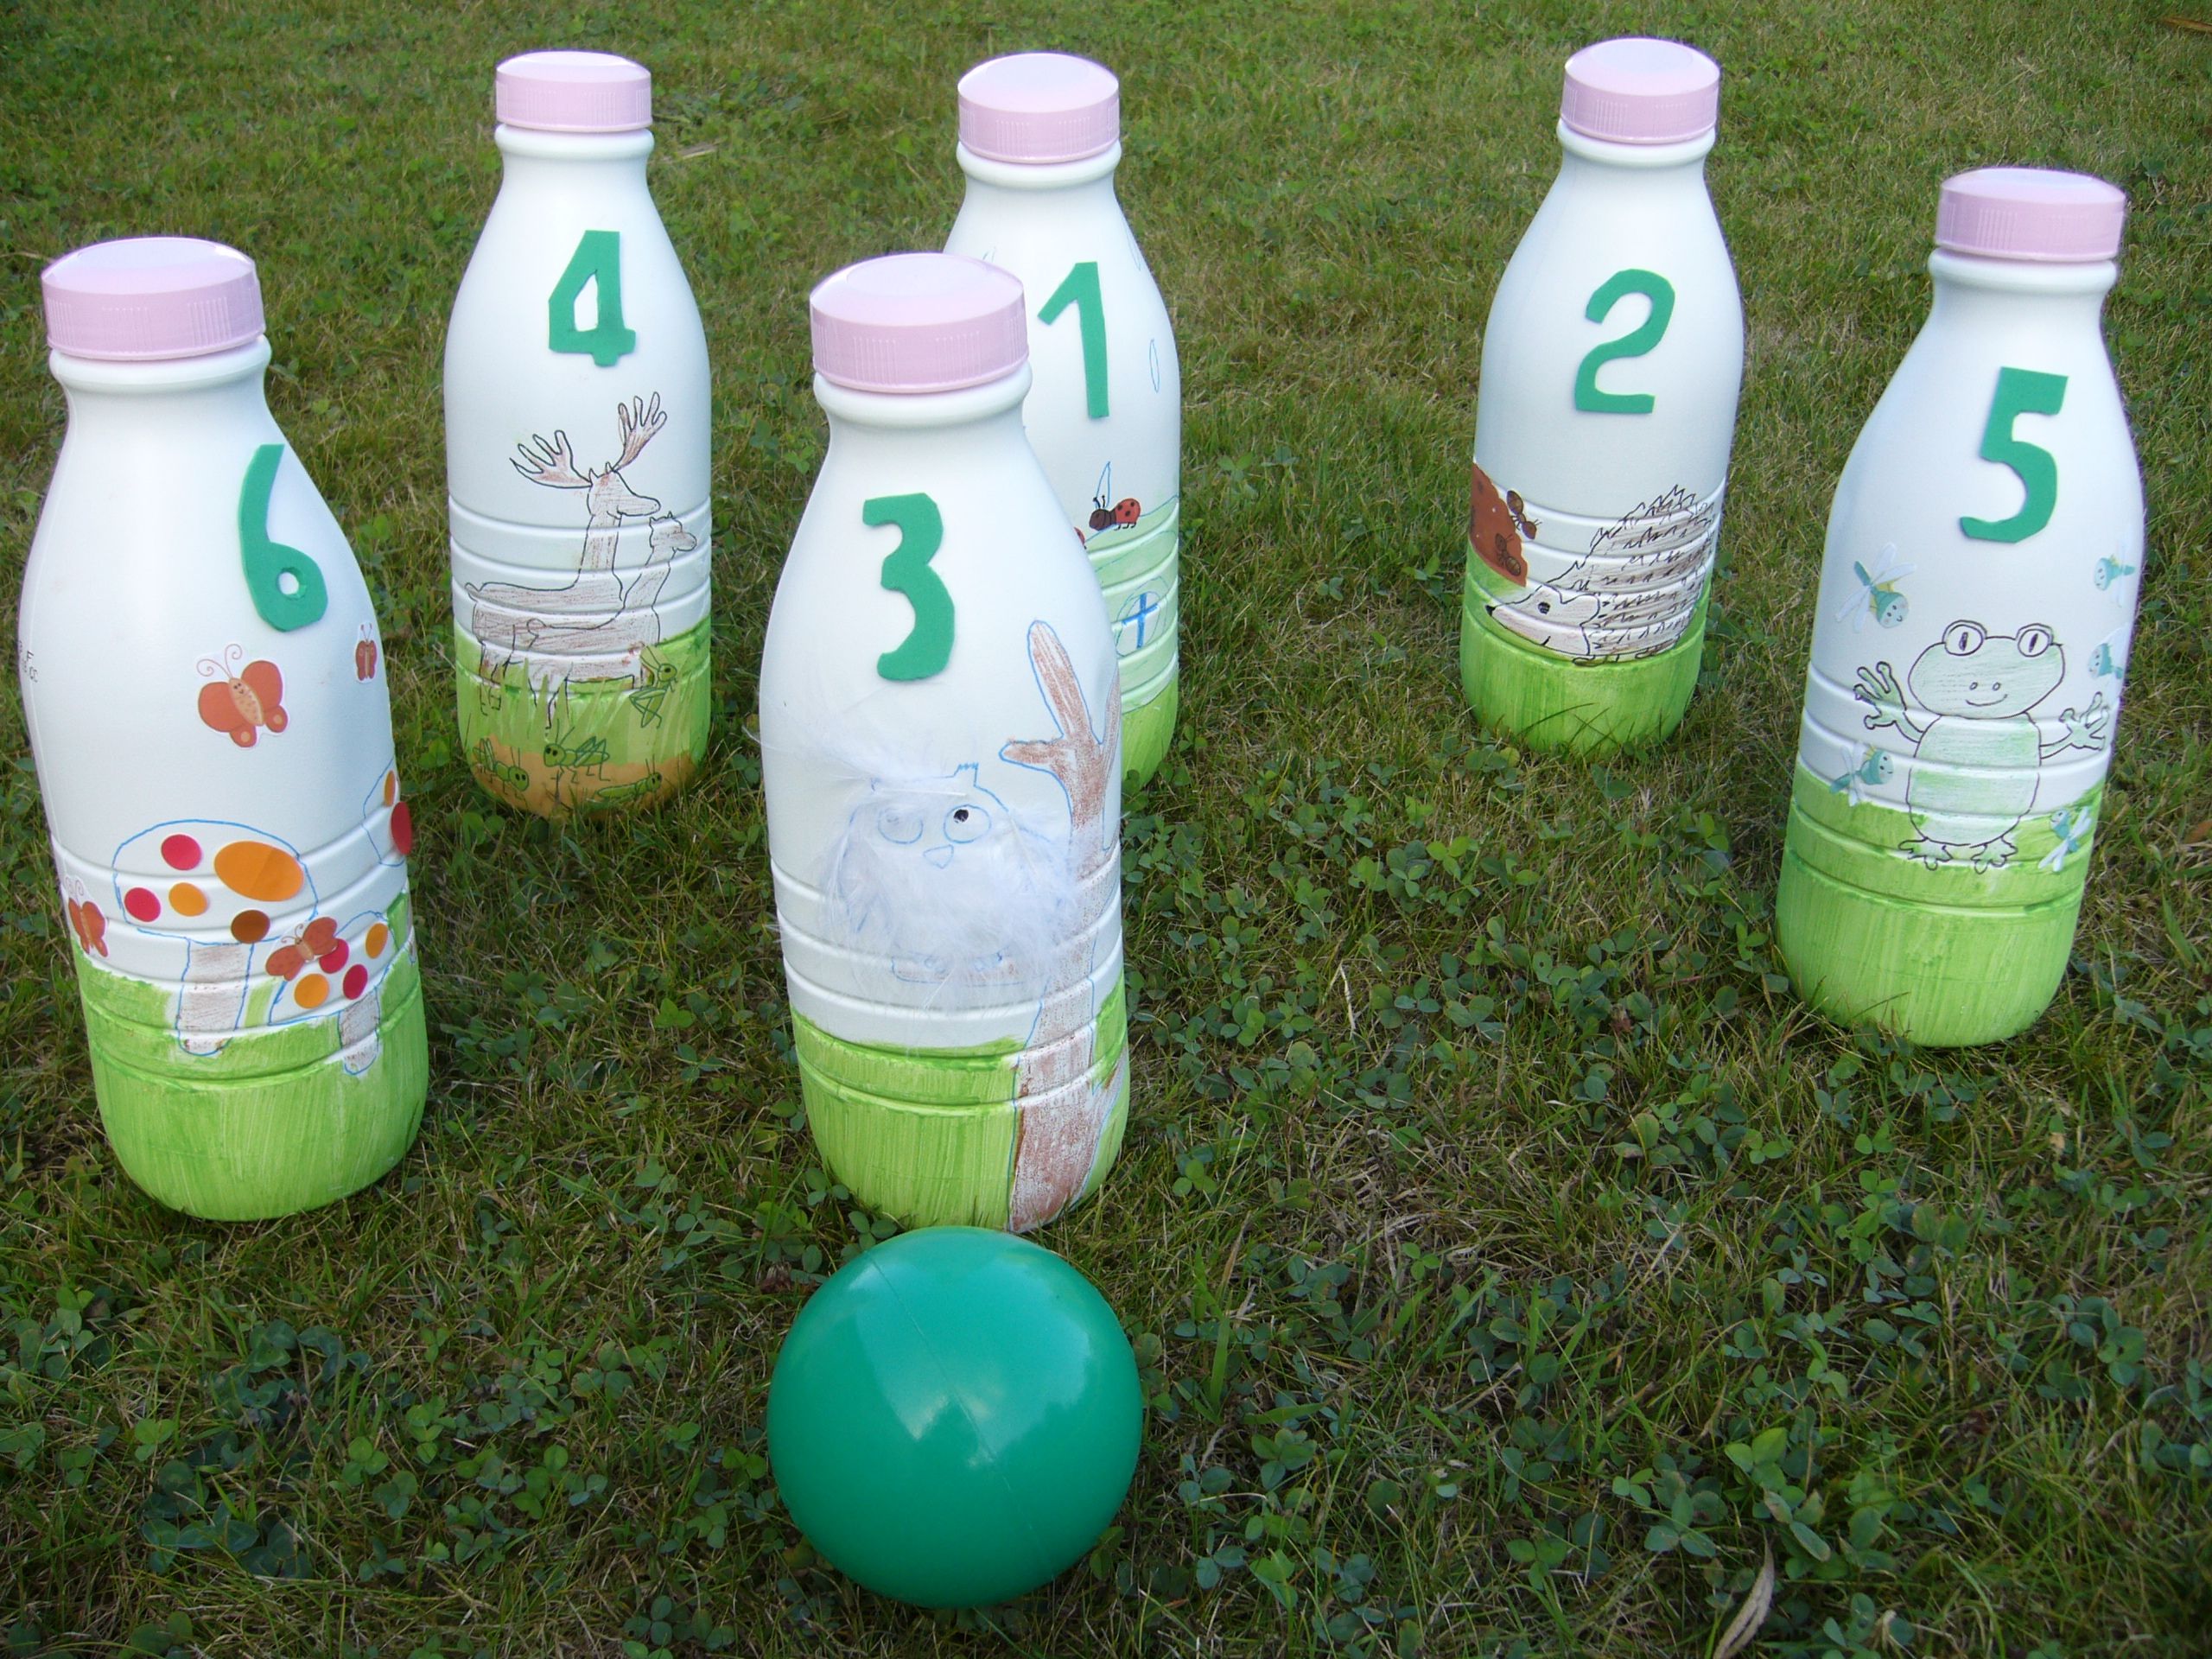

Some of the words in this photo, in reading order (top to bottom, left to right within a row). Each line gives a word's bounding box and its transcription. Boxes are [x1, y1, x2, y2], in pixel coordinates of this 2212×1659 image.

[550, 231, 635, 366] 4
[1039, 262, 1109, 418] 1
[1575, 270, 1675, 413] 2
[1960, 367, 2067, 542] 5
[239, 445, 327, 632] 6
[863, 493, 954, 680] 3
